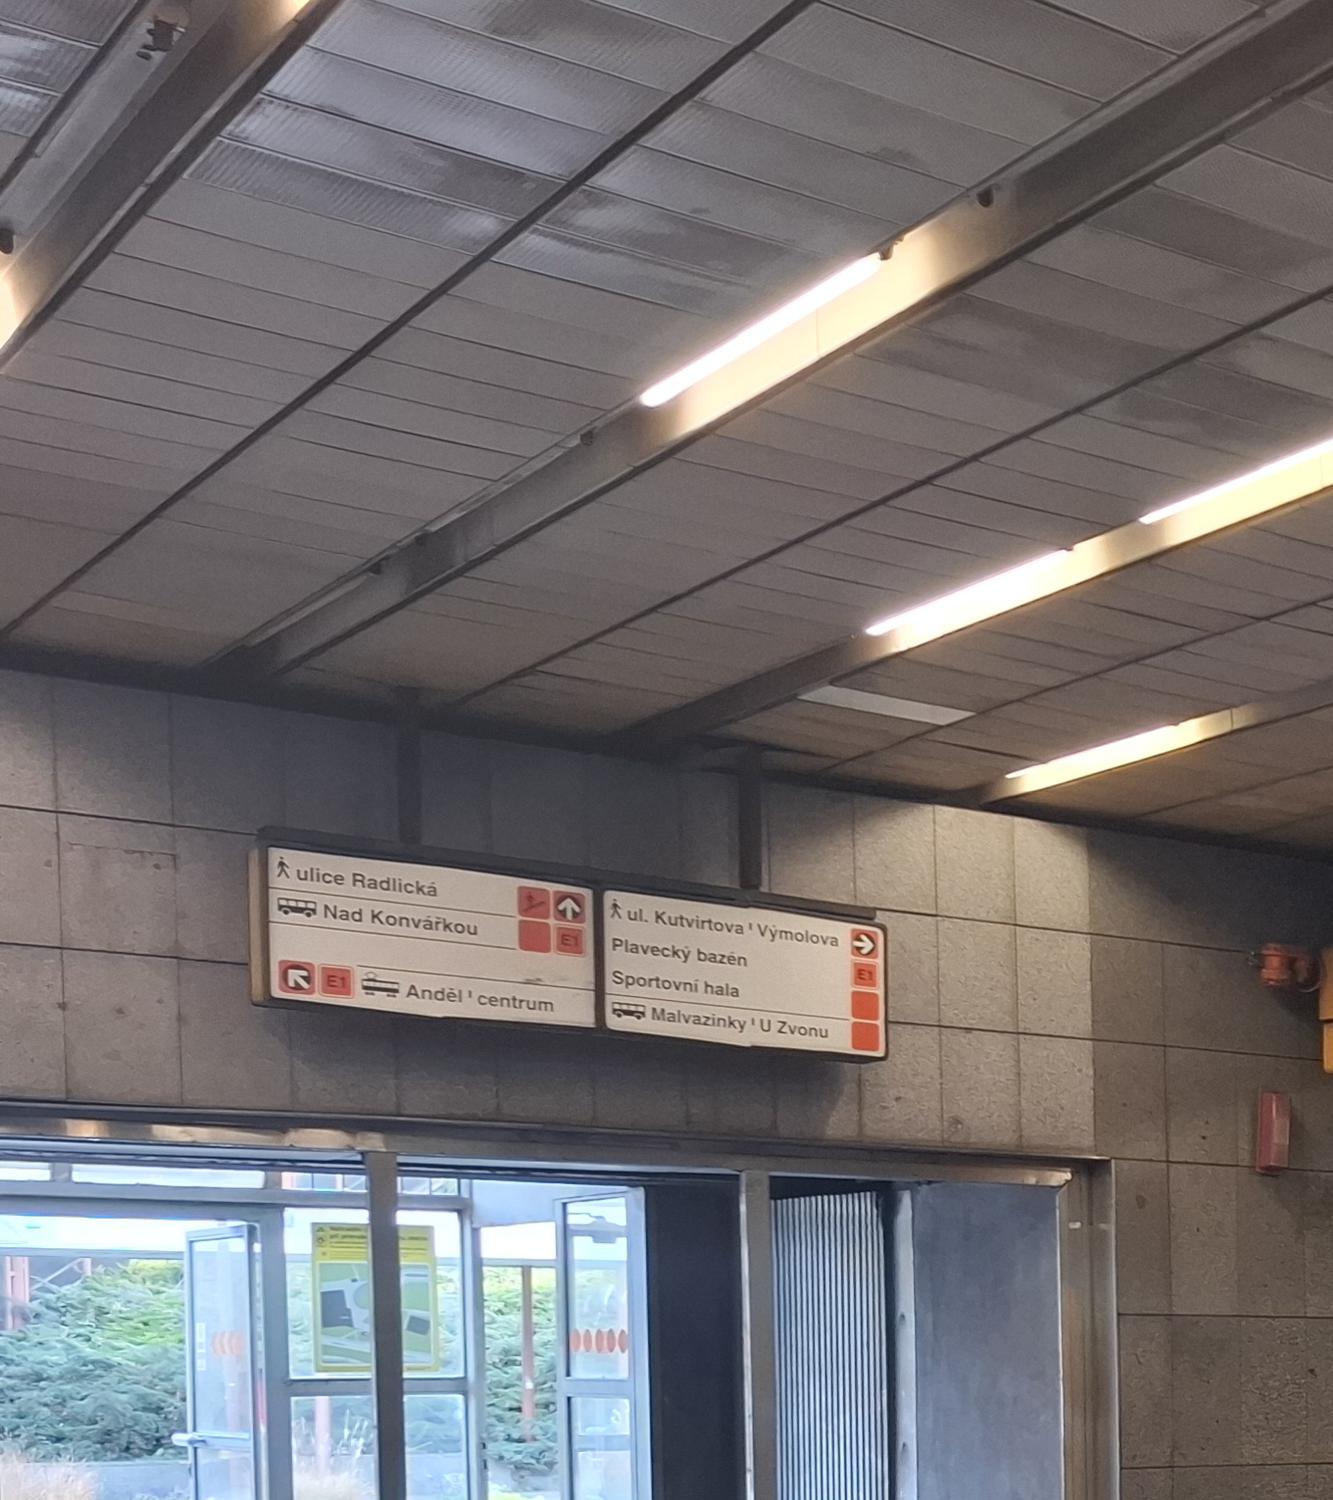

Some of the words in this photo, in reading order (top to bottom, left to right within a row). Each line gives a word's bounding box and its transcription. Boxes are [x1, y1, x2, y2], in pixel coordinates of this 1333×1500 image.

[296, 867, 345, 886] ulice
[352, 872, 438, 898] Radlická
[323, 904, 363, 923] Nad
[370, 909, 478, 936] Konvářkou
[627, 908, 649, 923] ul.
[654, 910, 744, 935] Kutvirtova
[757, 924, 839, 947] Výmolova
[560, 934, 579, 948] E1
[611, 938, 691, 963] Plavecký
[696, 948, 748, 968] bazén
[326, 974, 346, 989] E1
[611, 970, 699, 994] Sportovní
[704, 981, 740, 999] hala
[856, 968, 874, 982] E1
[406, 984, 463, 1003] Anděl
[477, 993, 555, 1012] centrum
[651, 1007, 747, 1033] Malvazinky
[759, 1018, 772, 1033] U
[777, 1020, 829, 1038] Zvonu
